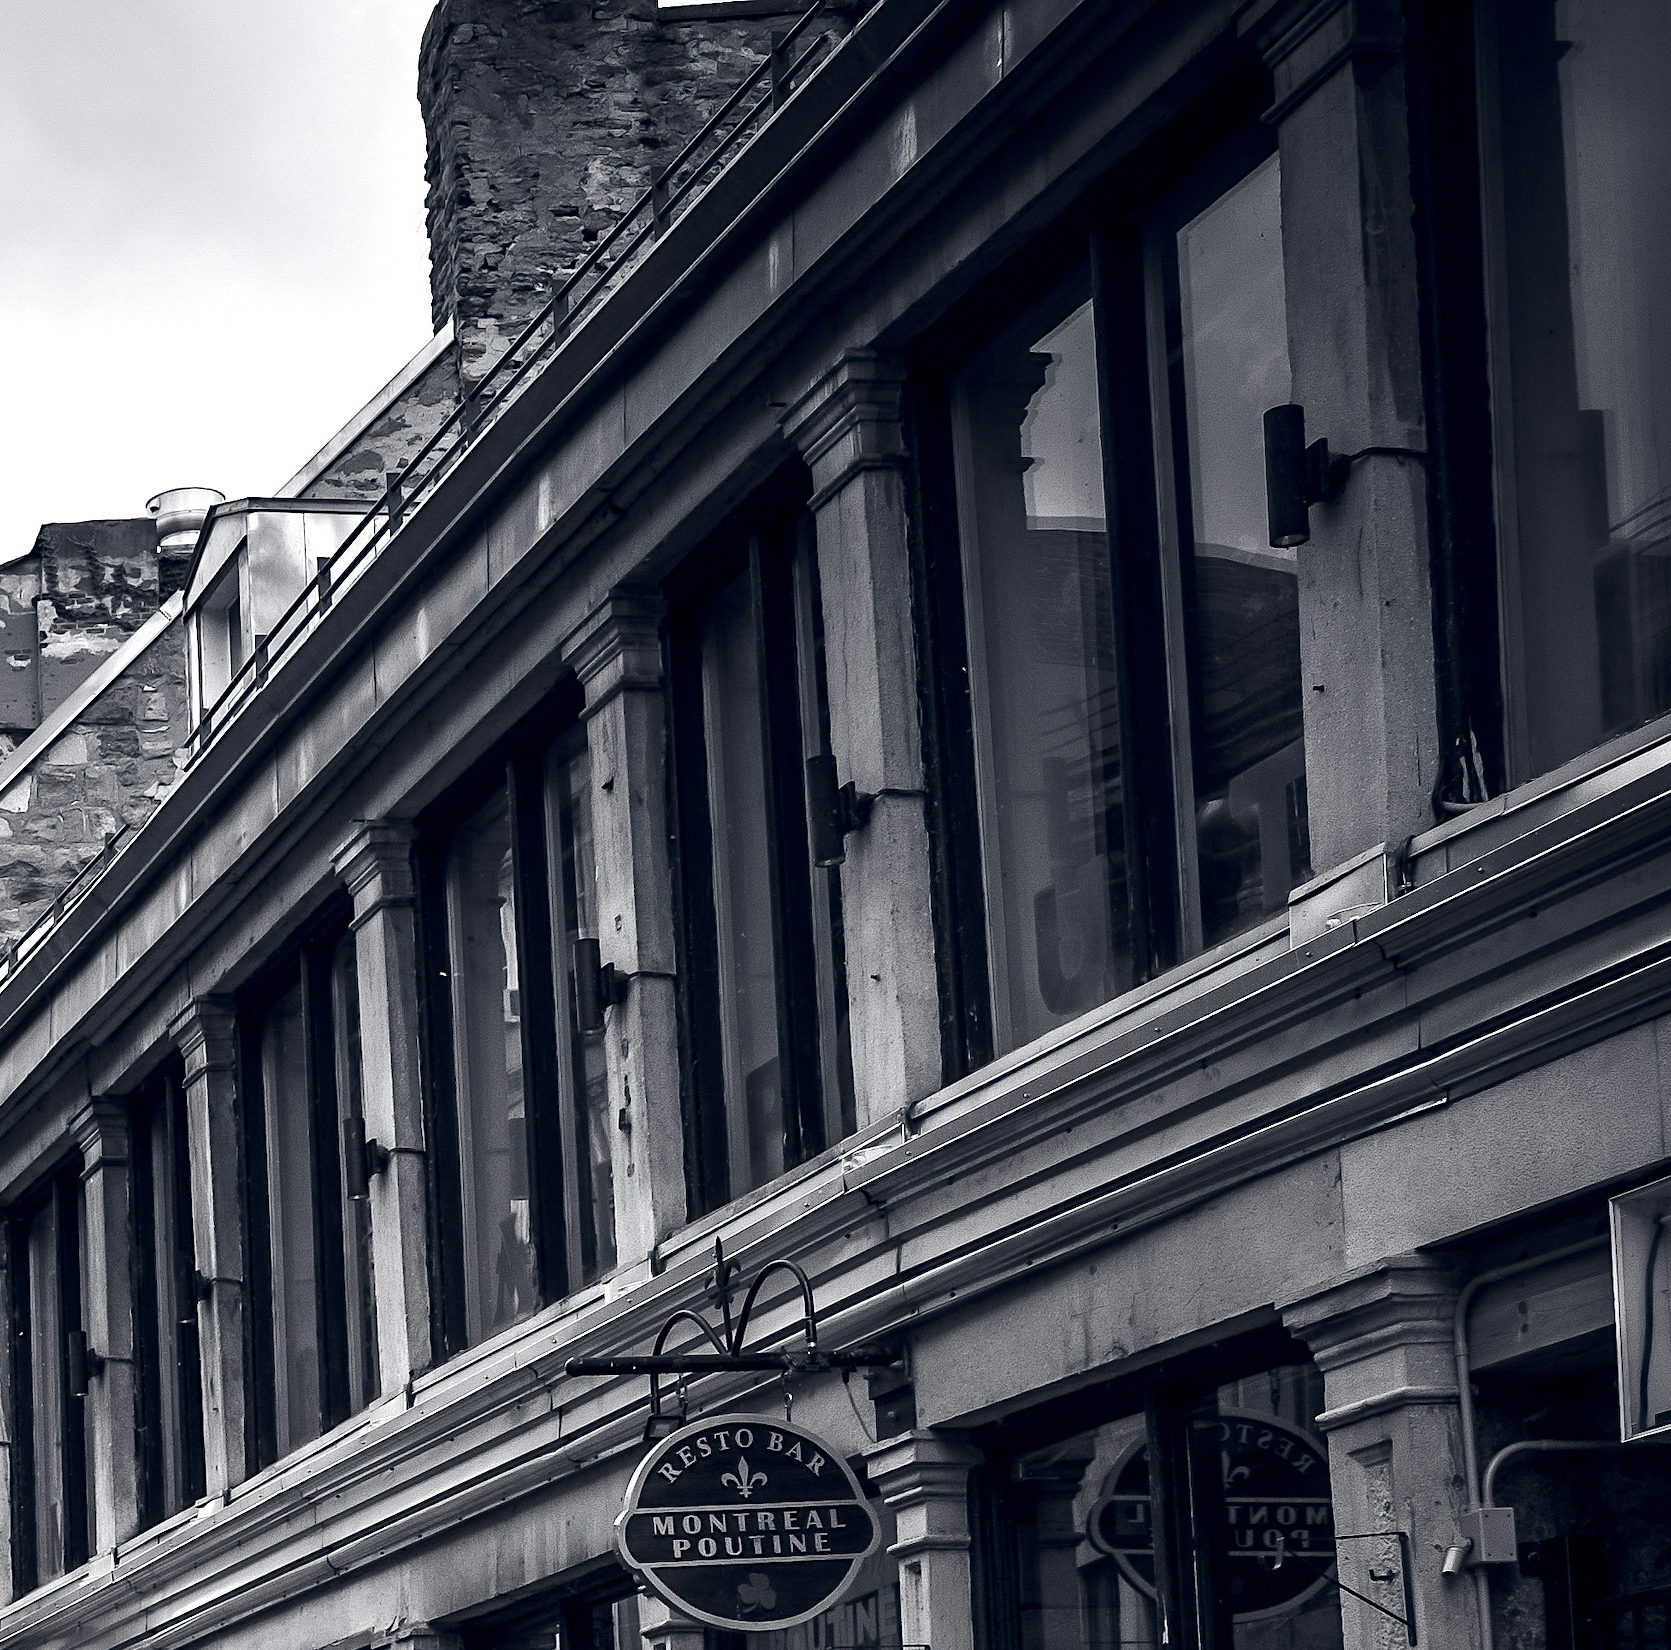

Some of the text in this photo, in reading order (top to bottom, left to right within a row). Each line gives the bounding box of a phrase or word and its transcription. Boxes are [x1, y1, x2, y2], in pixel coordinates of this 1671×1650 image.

[658, 1428, 826, 1484] RESTO BAR
[653, 1508, 847, 1536] MONTREAL
[672, 1532, 831, 1559] POUTINE
